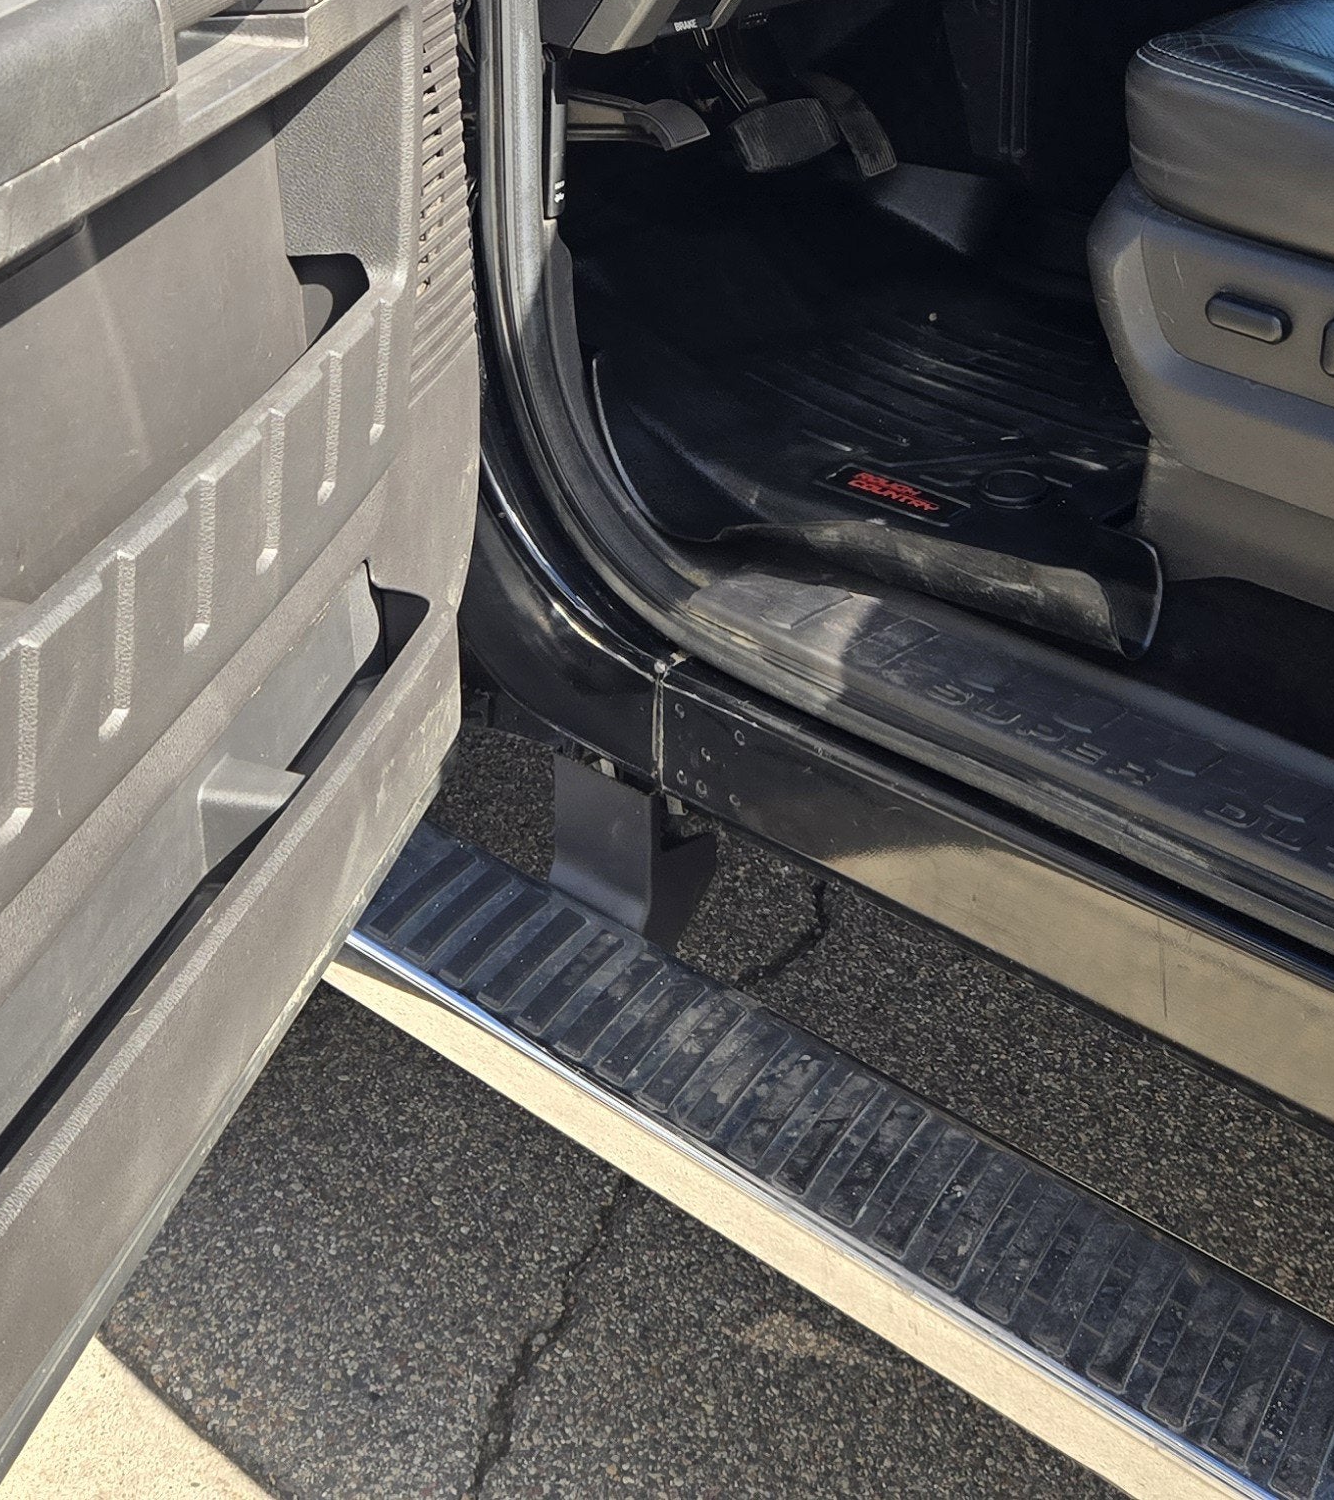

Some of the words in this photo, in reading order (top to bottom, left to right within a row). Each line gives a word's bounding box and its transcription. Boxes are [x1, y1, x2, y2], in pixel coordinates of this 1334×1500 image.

[847, 480, 941, 512] COUNTRY
[852, 472, 923, 496] ROUGH
[926, 678, 1159, 788] SUPER
